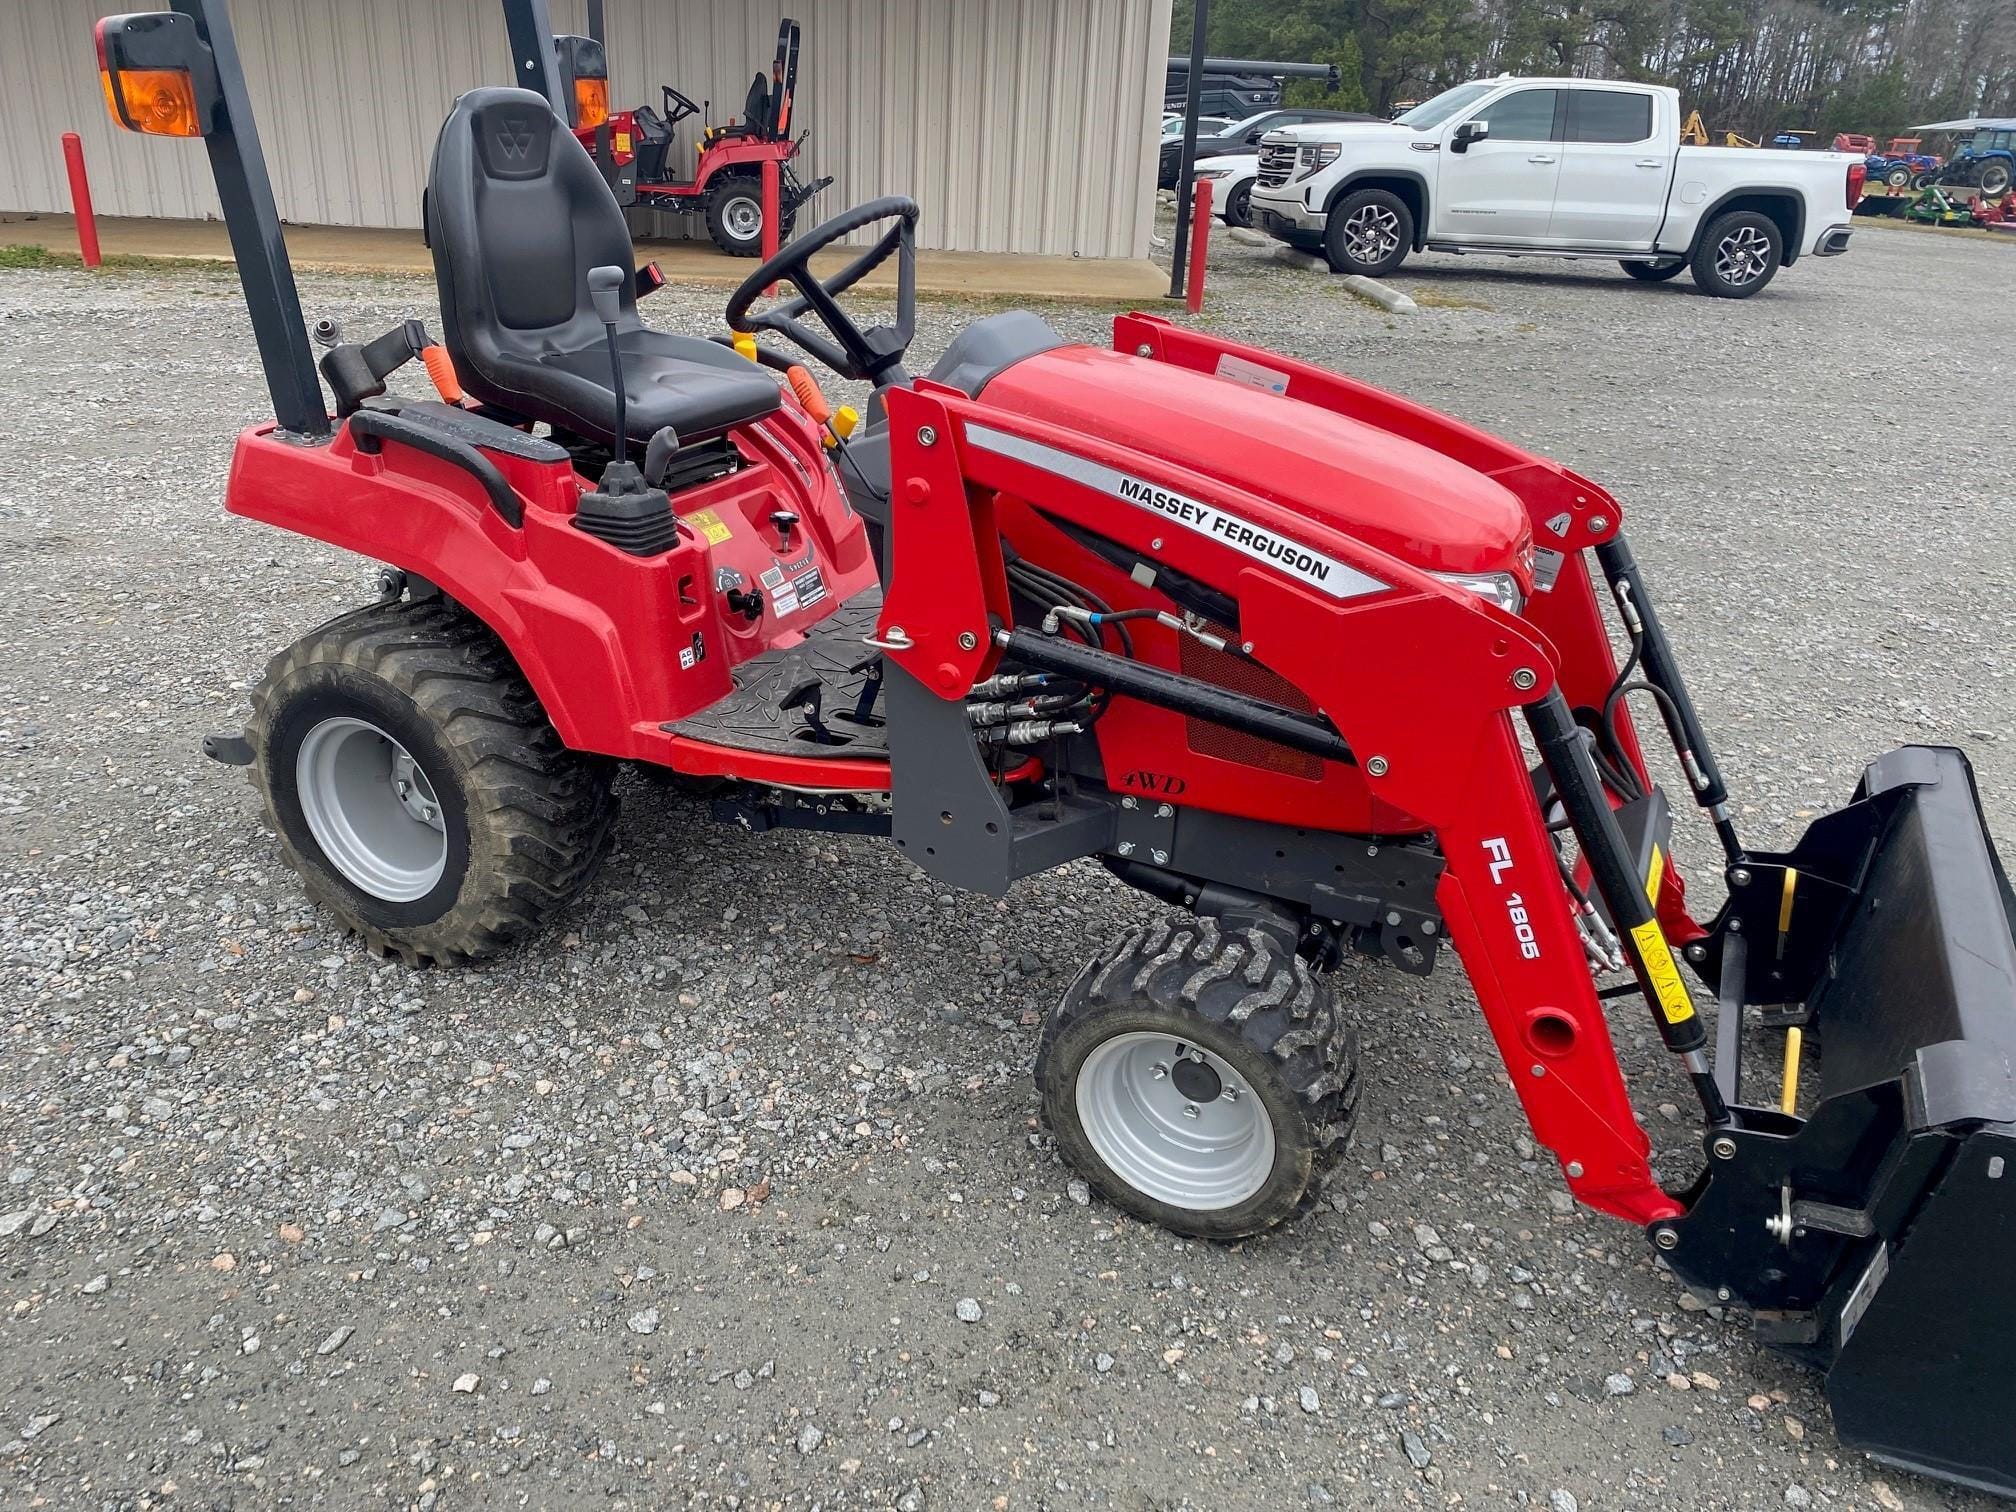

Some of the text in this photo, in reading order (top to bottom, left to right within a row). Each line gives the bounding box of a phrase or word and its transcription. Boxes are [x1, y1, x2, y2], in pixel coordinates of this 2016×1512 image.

[1119, 478, 1330, 581] MASSEY FERGUSON
[1120, 771, 1186, 795] 4WD
[1481, 837, 1541, 959] FL 1805
